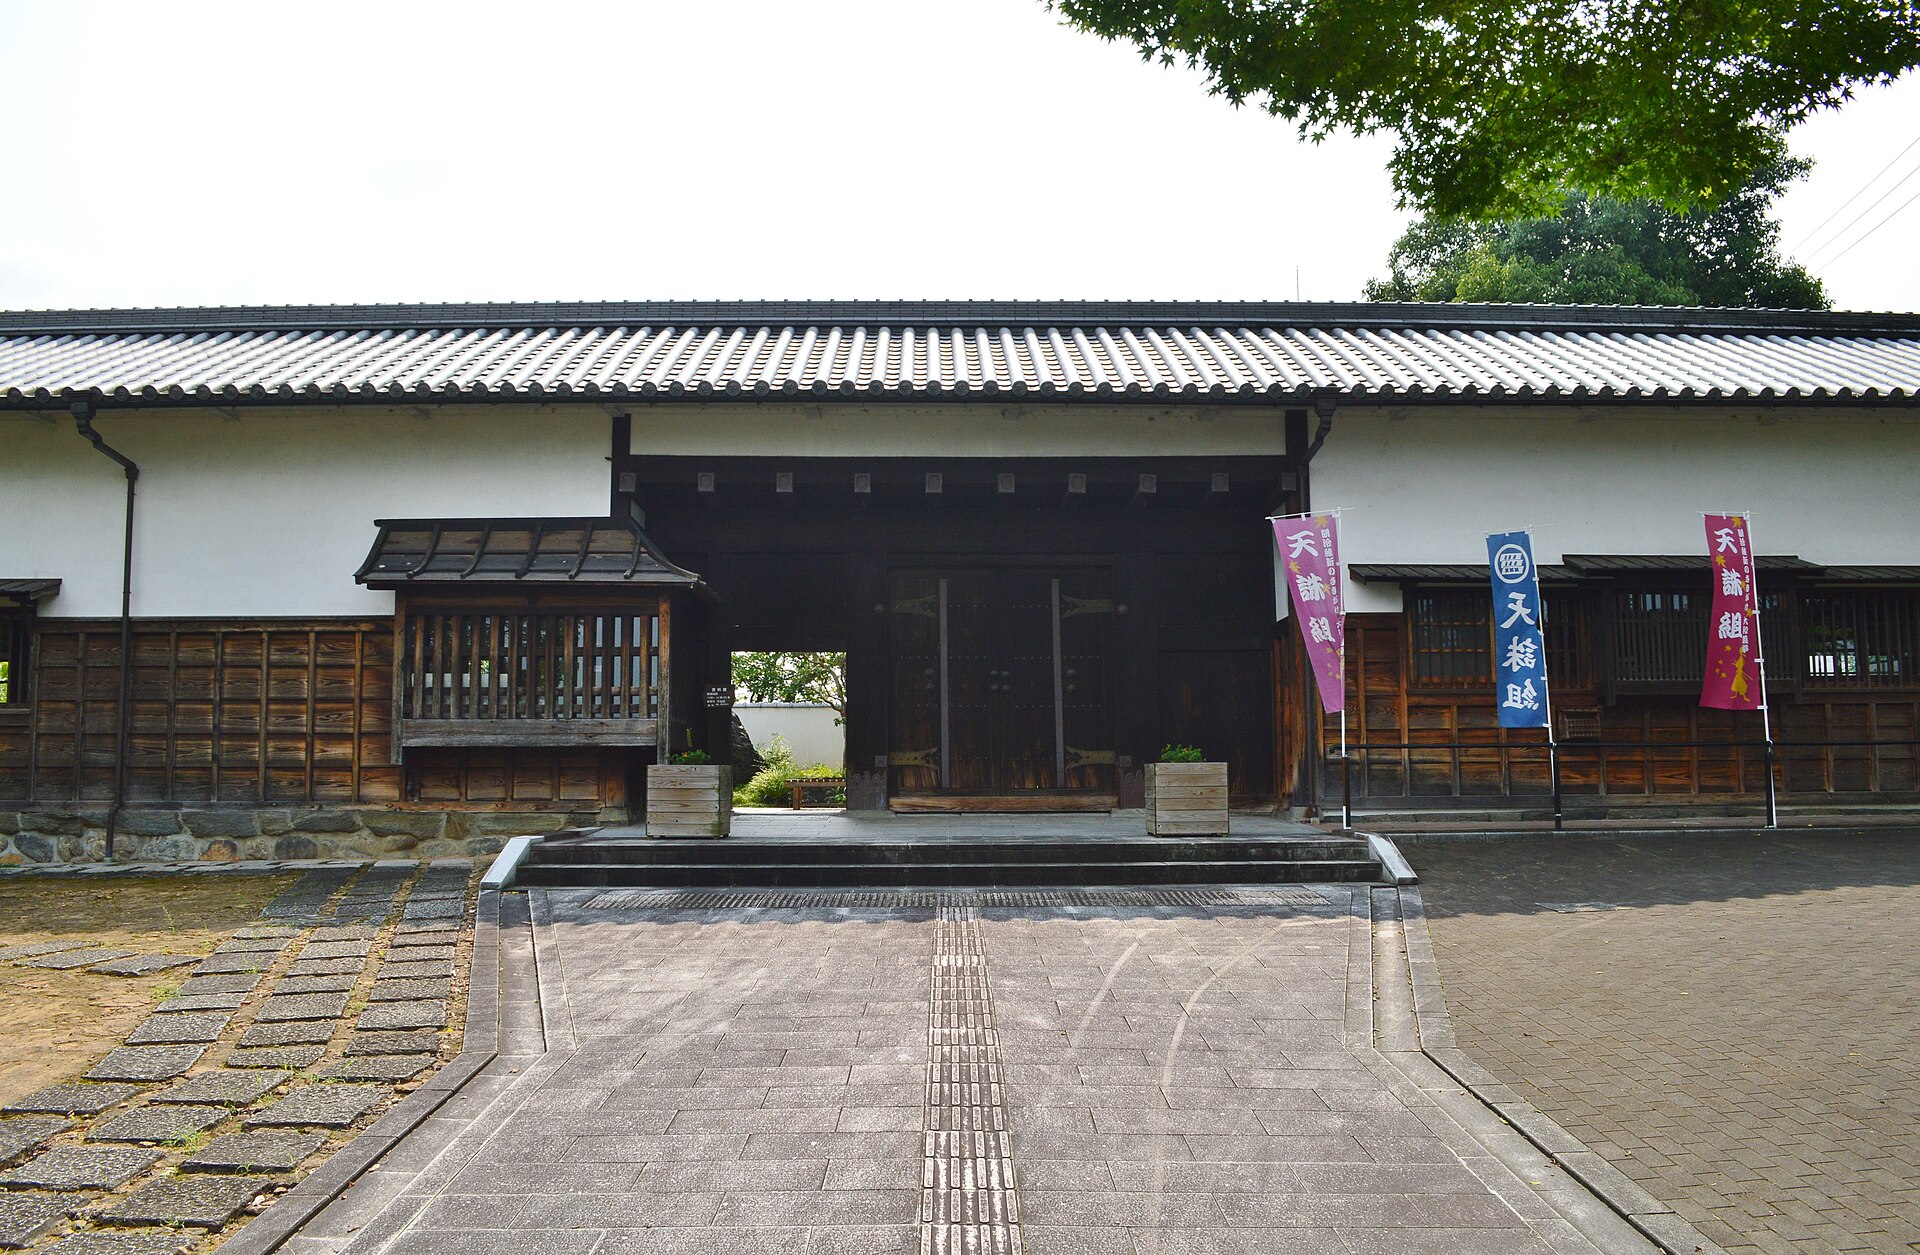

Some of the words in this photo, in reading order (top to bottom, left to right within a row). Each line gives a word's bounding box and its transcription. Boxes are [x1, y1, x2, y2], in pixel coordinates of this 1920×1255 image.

[1286, 530, 1336, 643] 天誅組
[1714, 528, 1743, 639] 天誅組
